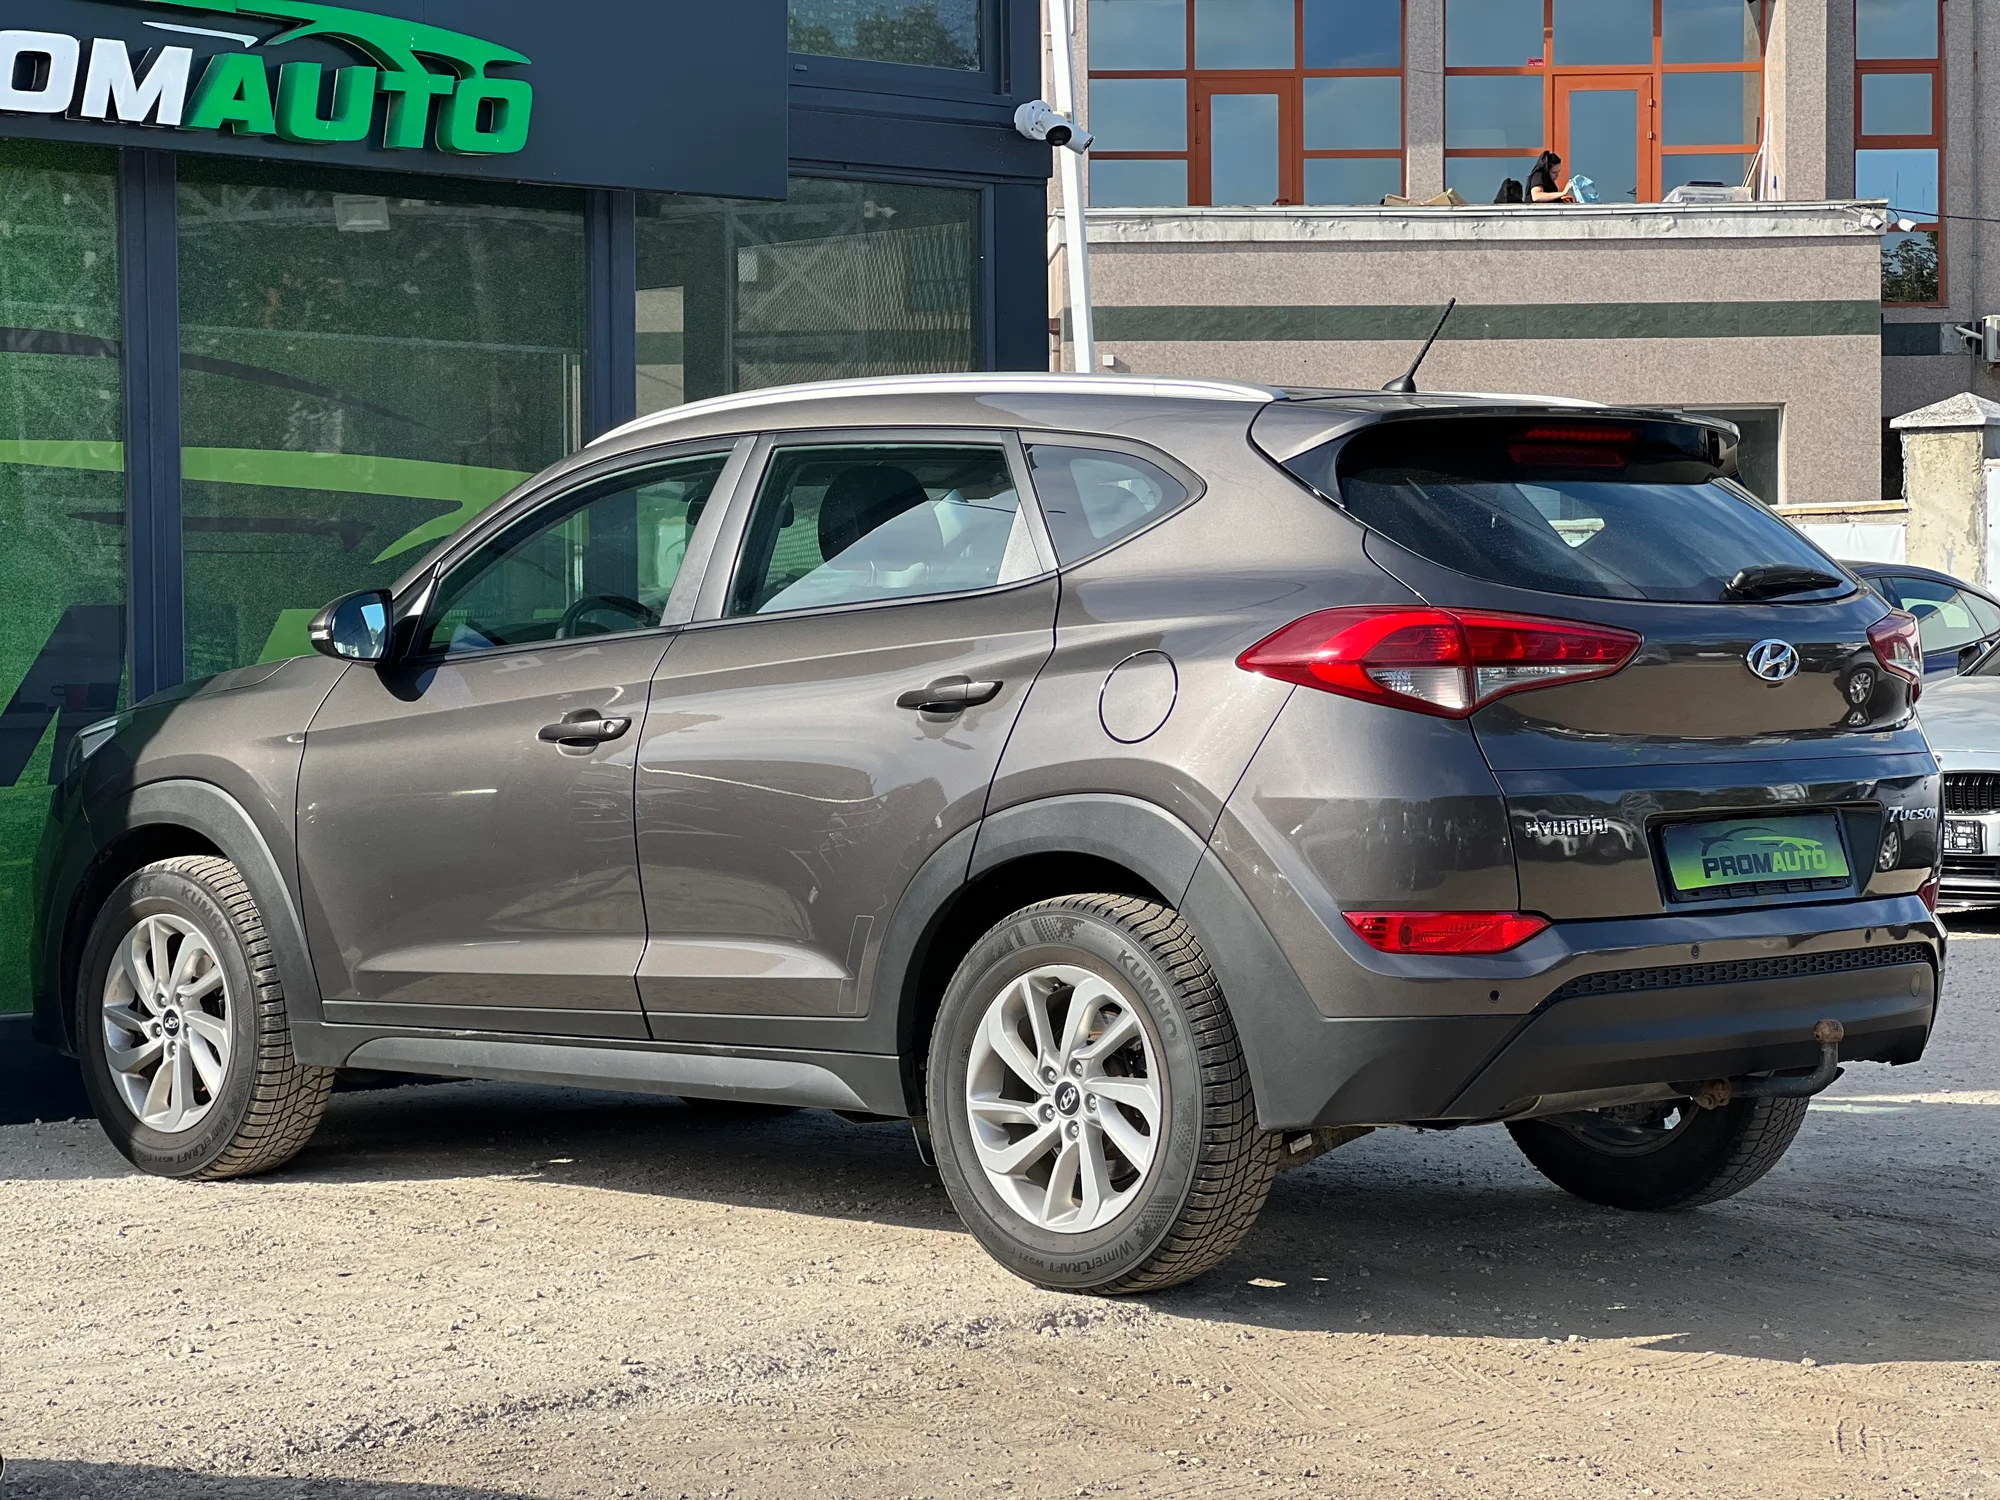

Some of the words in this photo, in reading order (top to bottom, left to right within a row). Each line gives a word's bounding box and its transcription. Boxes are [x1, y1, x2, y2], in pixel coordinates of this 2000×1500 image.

[1525, 818, 1608, 838] HYUNDAI
[1702, 849, 1828, 879] PROMAUTO
[181, 885, 229, 942] KUMHO
[1116, 948, 1178, 1039] KUMHO
